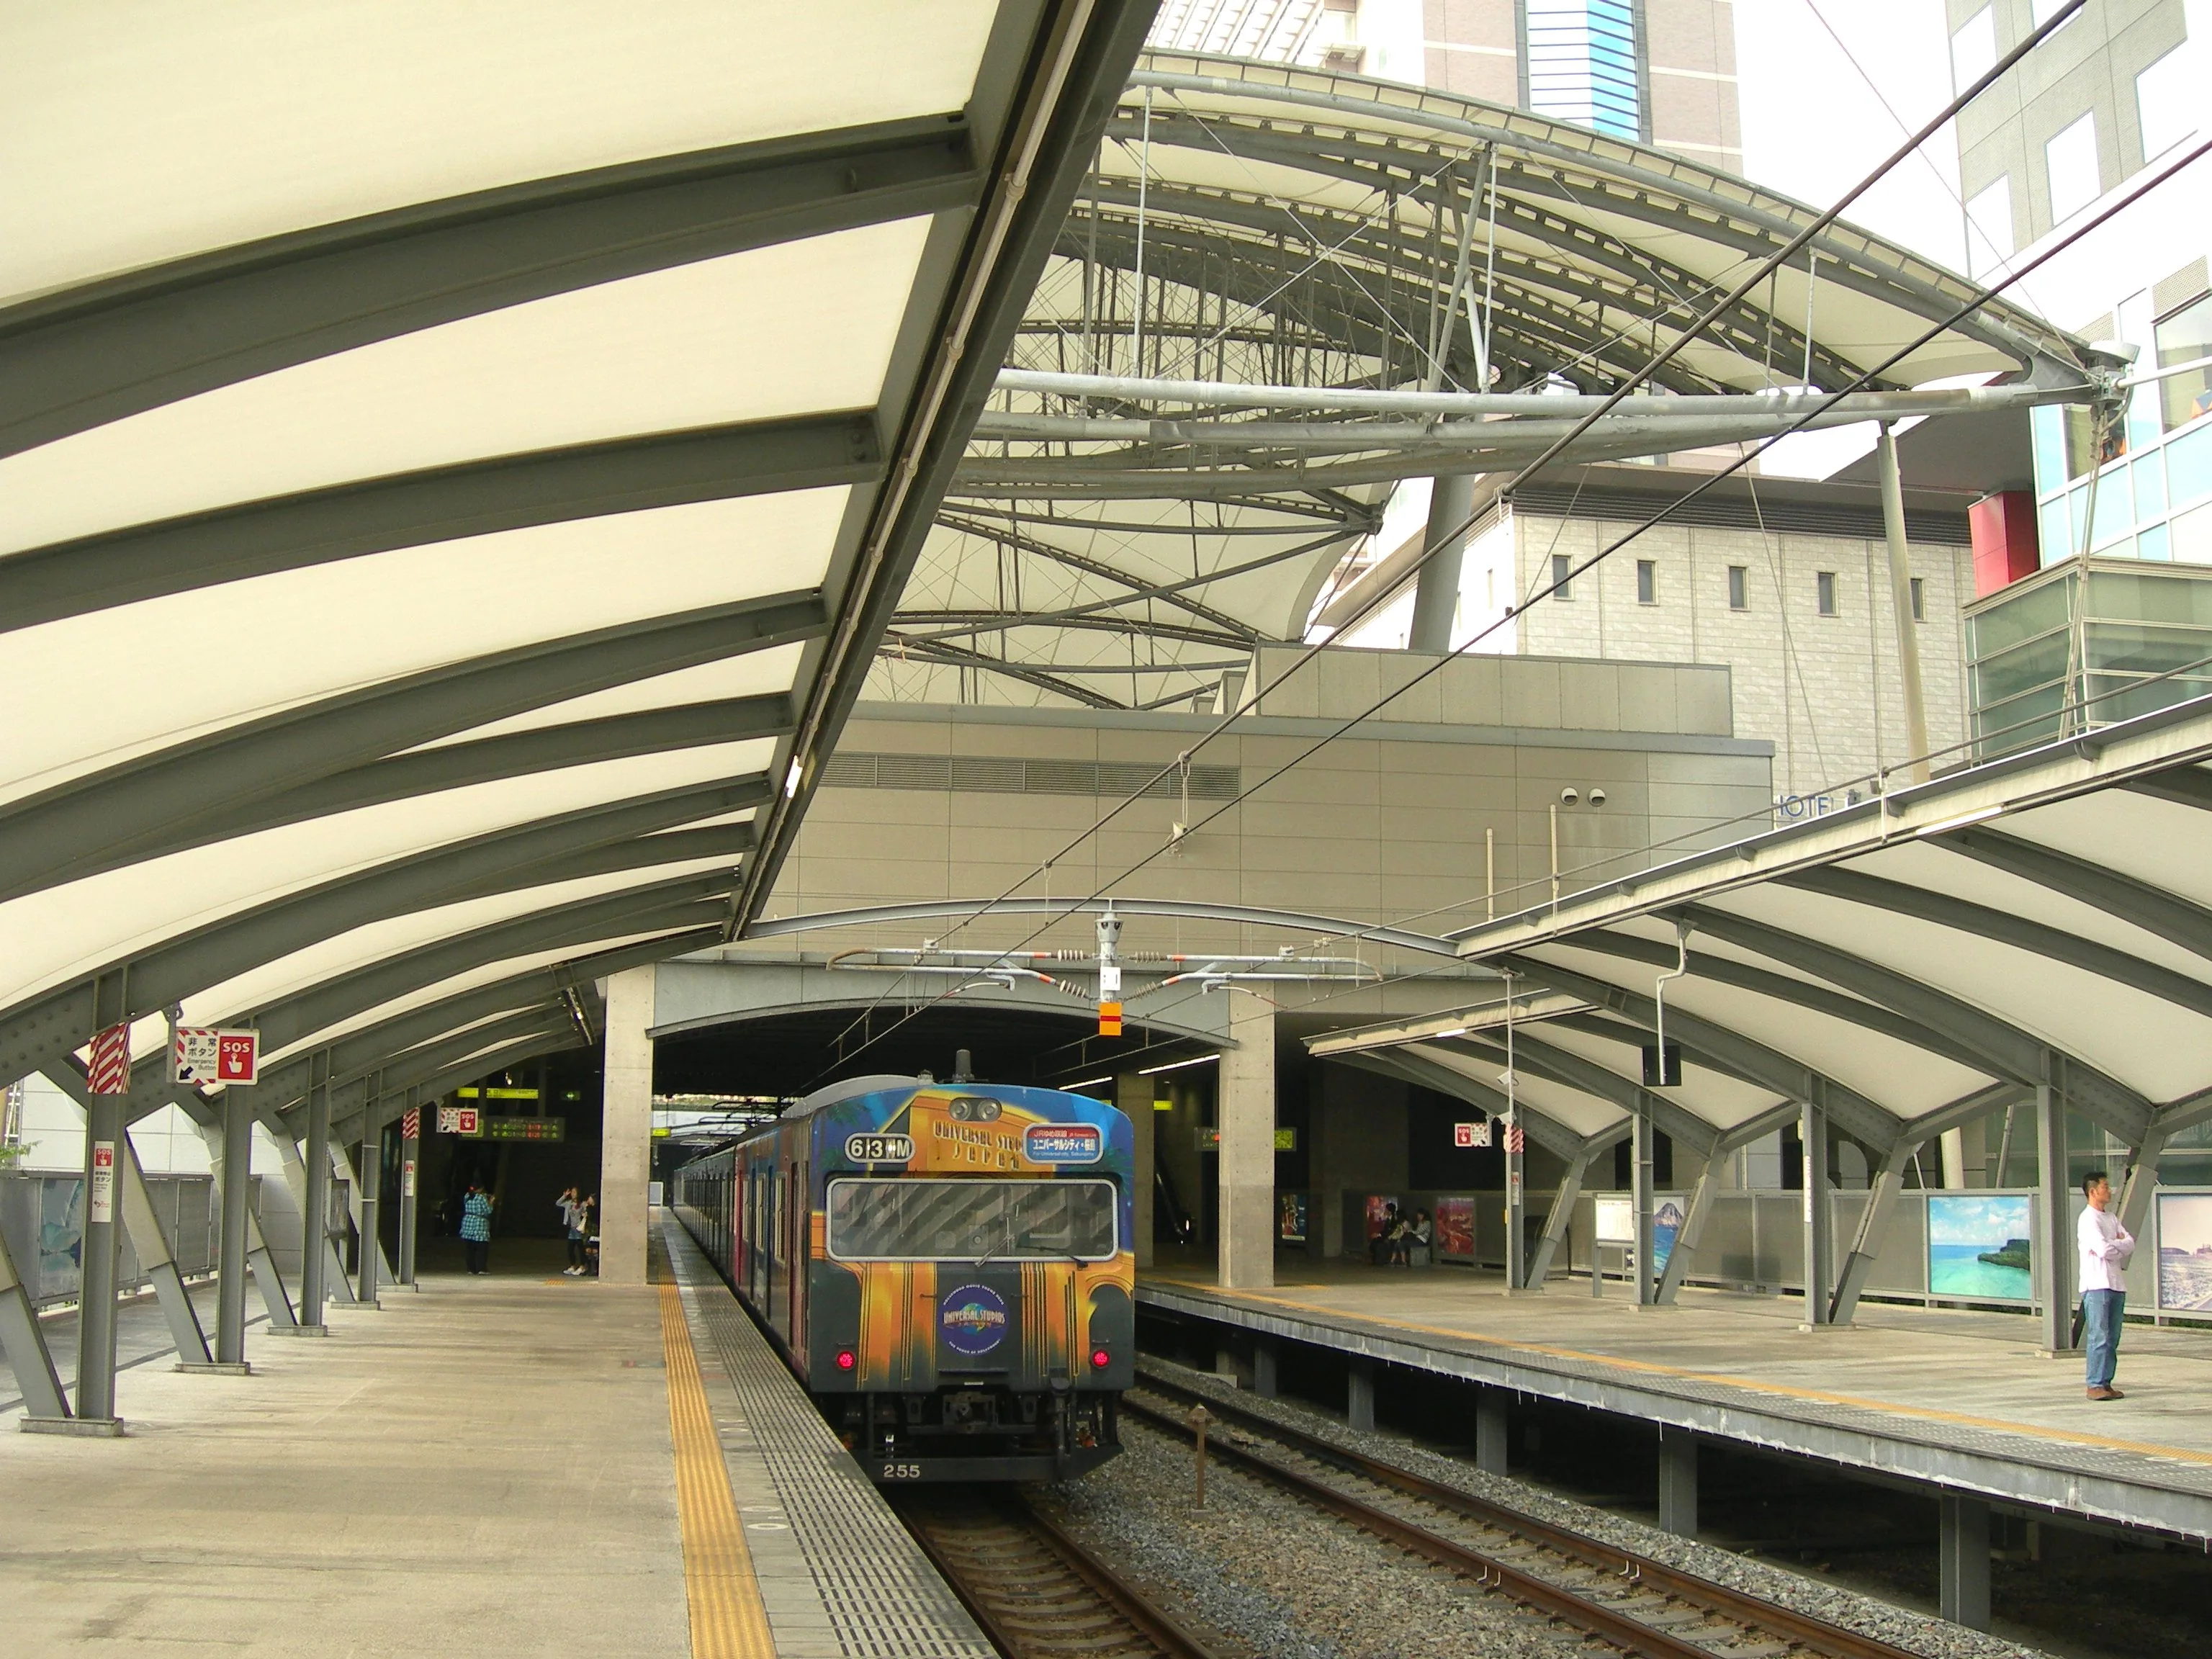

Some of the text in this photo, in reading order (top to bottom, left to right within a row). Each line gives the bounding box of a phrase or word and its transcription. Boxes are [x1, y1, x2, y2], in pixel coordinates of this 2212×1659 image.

[188, 1048, 217, 1056] ボタン
[222, 1042, 251, 1053] SOS
[933, 1120, 993, 1147] UNIVERSAL
[943, 1310, 1005, 1324] UNIVERSAL STUDIOS
[884, 1464, 921, 1478] 255
